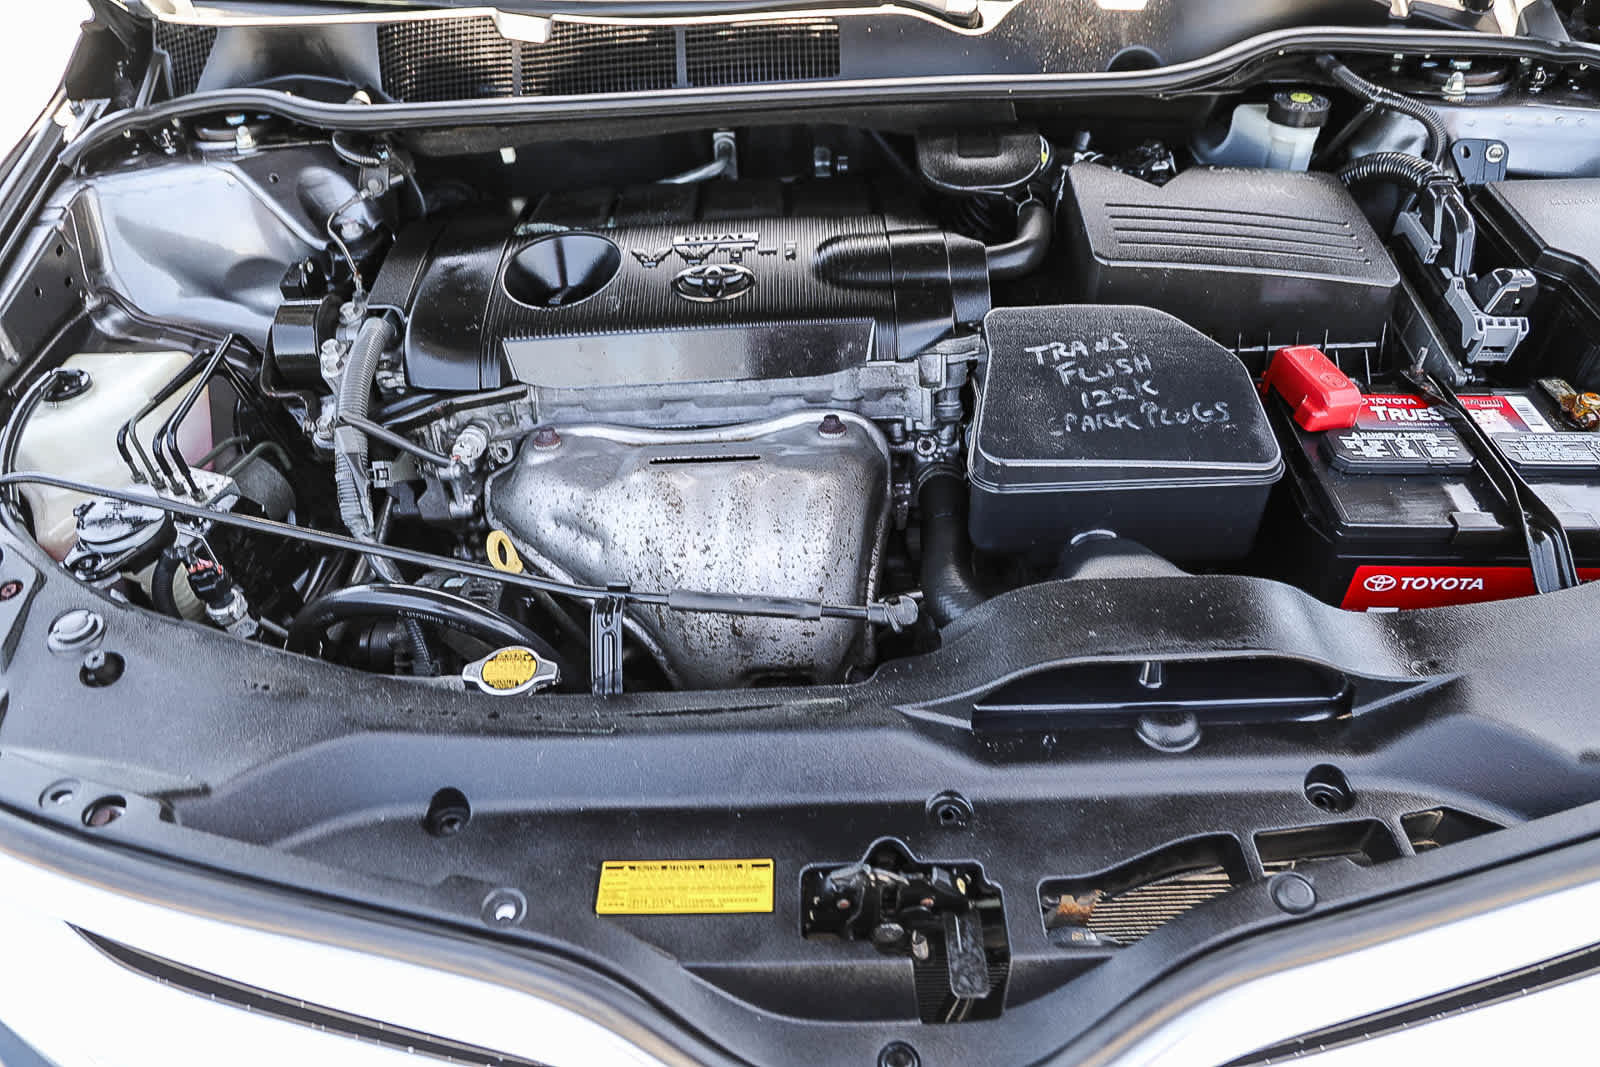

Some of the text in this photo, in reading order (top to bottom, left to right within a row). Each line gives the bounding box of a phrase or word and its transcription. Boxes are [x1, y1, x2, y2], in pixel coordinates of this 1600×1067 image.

[1024, 332, 1129, 366] TRANS
[1055, 353, 1153, 386] FLUSH
[1367, 397, 1417, 406] TOYOTA
[1400, 576, 1485, 591] TOYOTA
